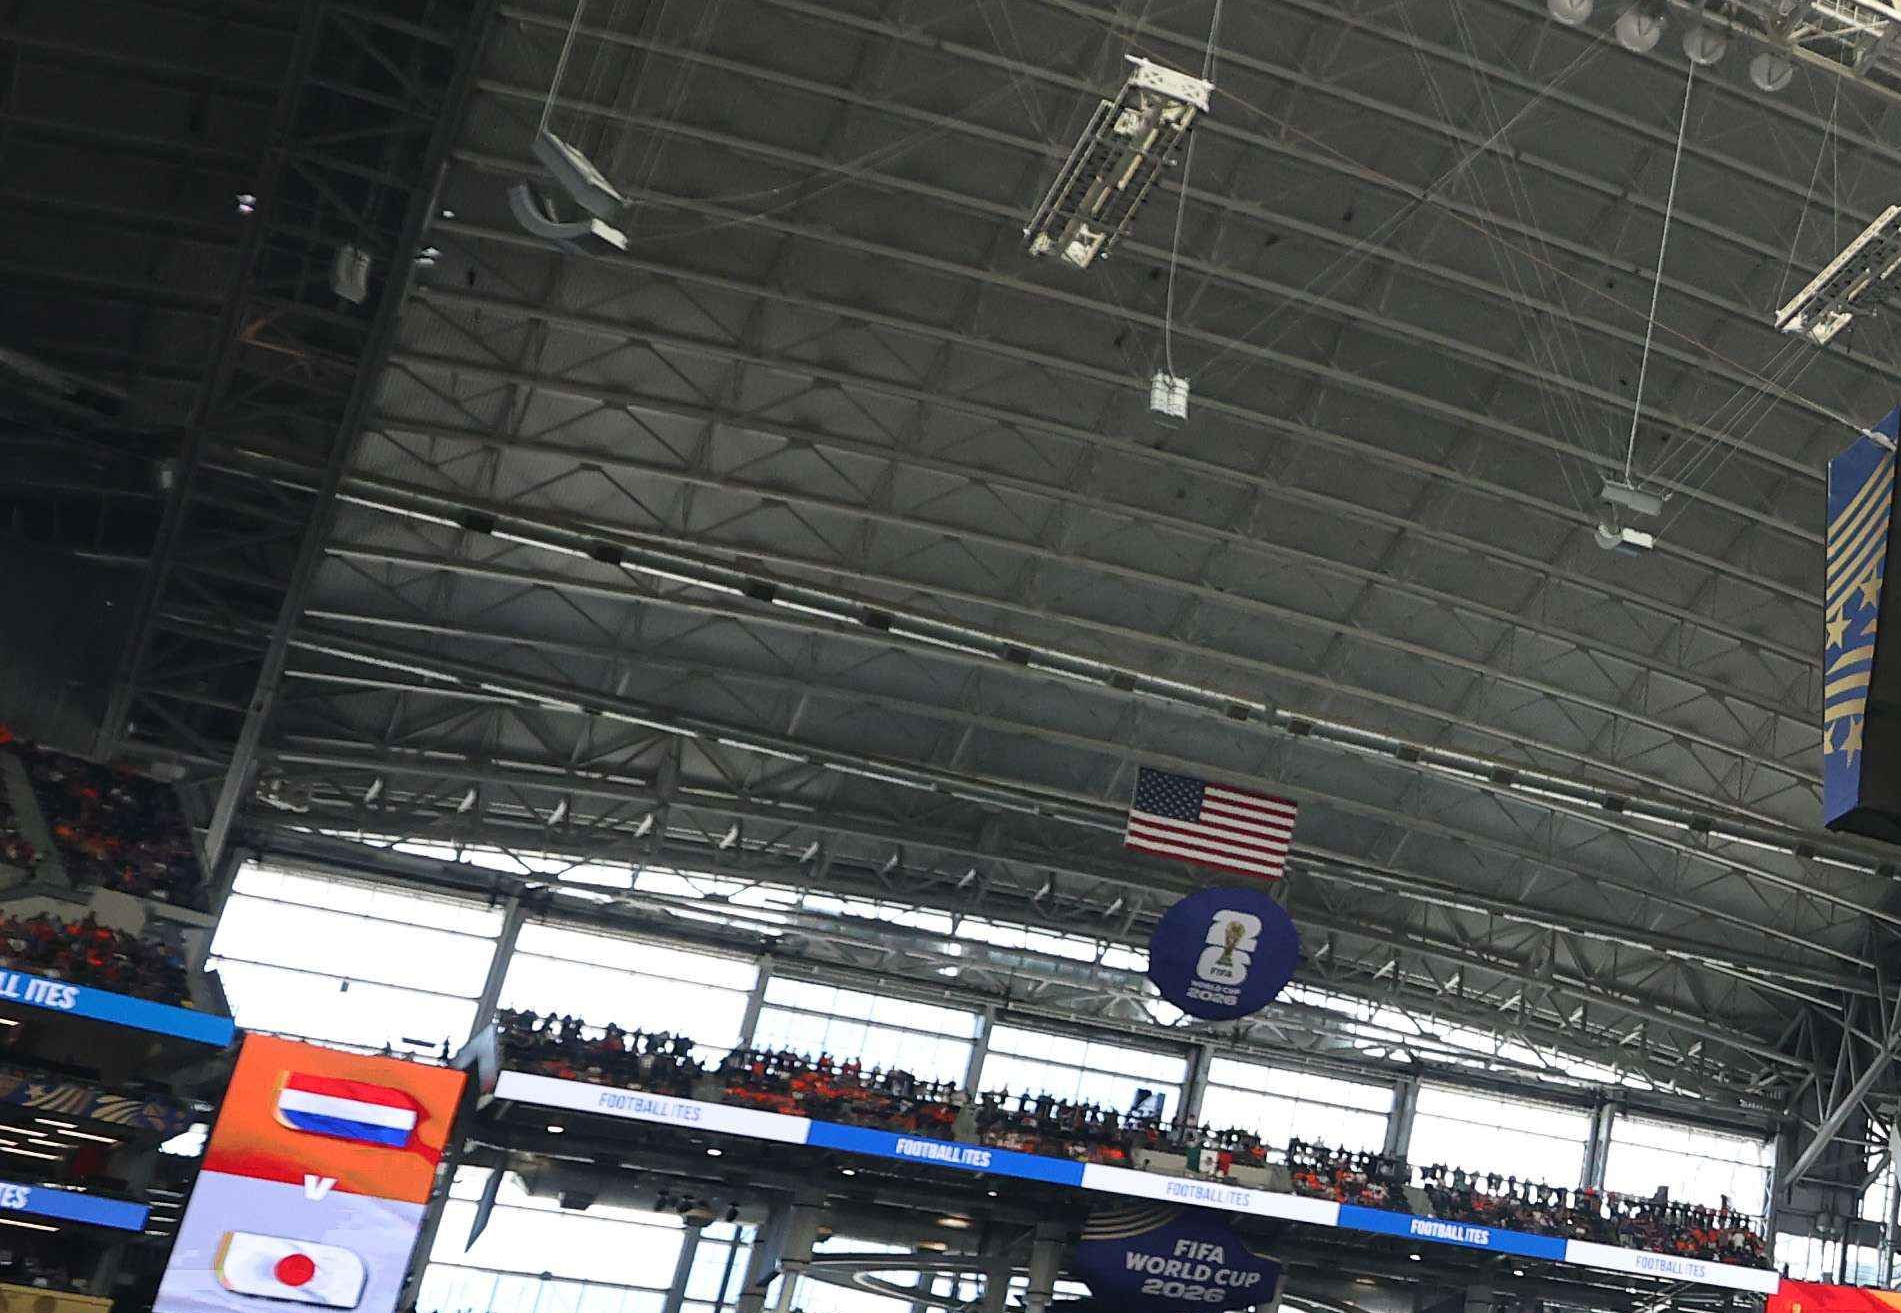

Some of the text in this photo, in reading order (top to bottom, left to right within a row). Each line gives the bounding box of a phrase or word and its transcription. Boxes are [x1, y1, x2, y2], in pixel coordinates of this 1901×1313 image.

[1186, 987, 1238, 1006] 2026
[599, 1091, 668, 1117] FOOTBALL
[896, 1138, 961, 1163] FOOTBALL
[1166, 1180, 1222, 1203] FOOTBALL
[1411, 1219, 1464, 1242] FOOTBALL
[1174, 1239, 1225, 1265] FIFA
[1126, 1251, 1261, 1289] WORLD CUP
[1635, 1256, 1682, 1275] FOOTBALL
[1141, 1278, 1226, 1303] 2026
